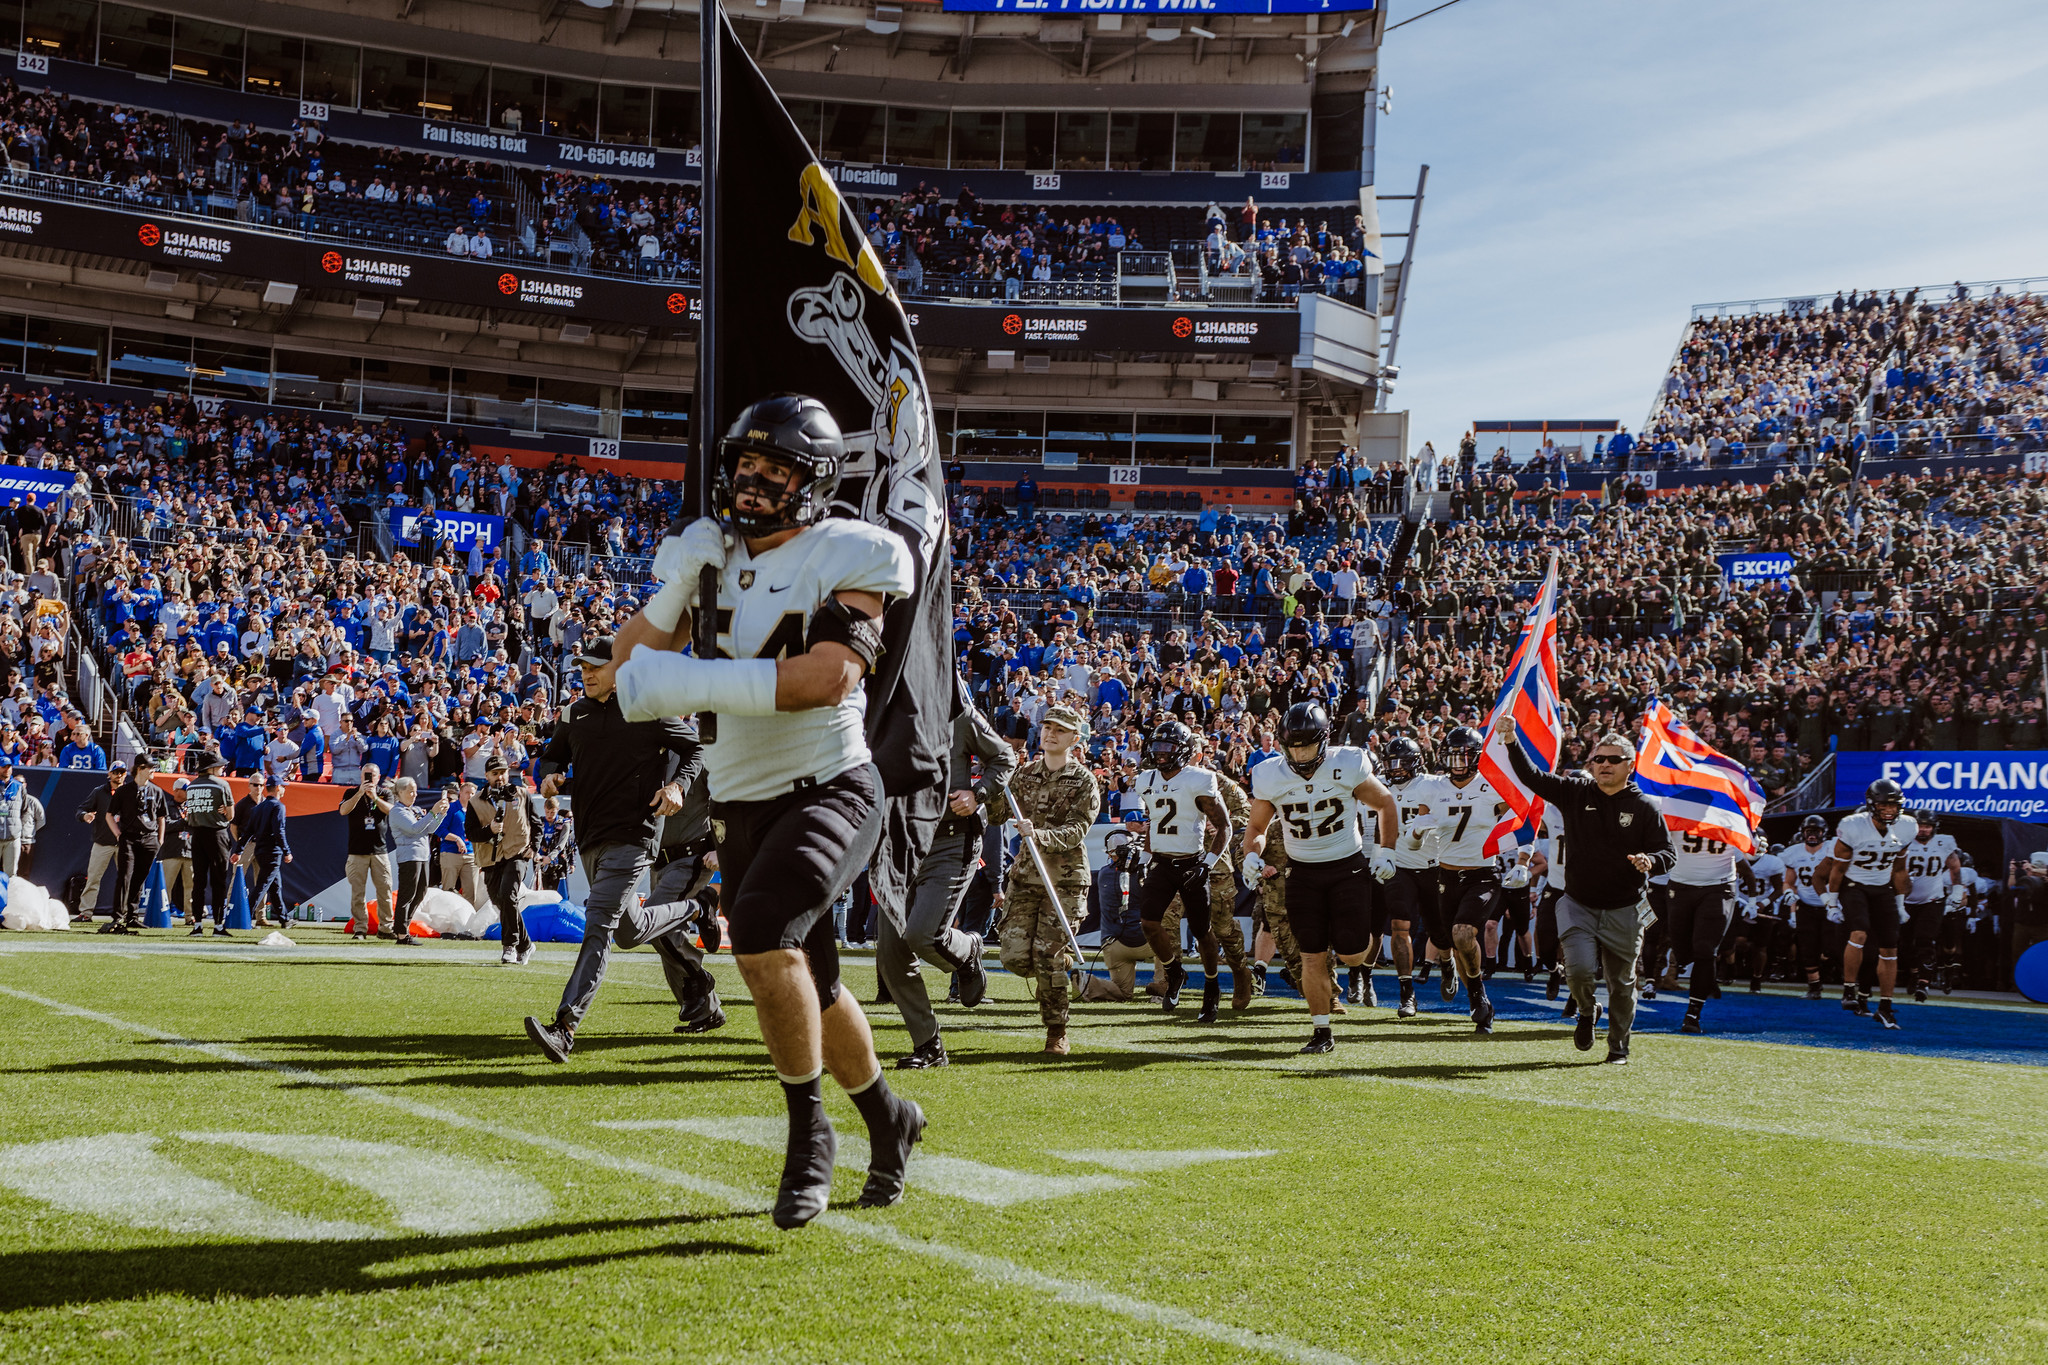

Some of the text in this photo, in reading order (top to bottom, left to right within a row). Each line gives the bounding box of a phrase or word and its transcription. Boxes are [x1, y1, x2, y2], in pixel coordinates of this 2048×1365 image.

[20, 55, 45, 71] 342
[302, 104, 326, 118] 343
[423, 123, 528, 154] Fan issues text
[559, 143, 656, 169] 720-650-6464
[687, 153, 702, 165] 34
[841, 166, 898, 186] location
[1035, 175, 1059, 188] 345
[1264, 174, 1287, 187] 346
[163, 231, 232, 254] L3HARRIS
[163, 246, 223, 262] FAST. FORWARD.
[345, 257, 411, 278] L3HARRIS
[345, 272, 403, 287] FAST. FORWARD.
[520, 279, 583, 299] L3HARRIS
[520, 294, 576, 308] FAST. FORWARD.
[1024, 318, 1088, 331] L3HARRIS
[1195, 321, 1259, 335] L3HARRIS
[1024, 332, 1080, 341] FAST. FORWARD.
[1195, 335, 1251, 344] FAST. FORWARD.
[196, 400, 221, 416] 127
[747, 429, 769, 440] ARMY
[592, 441, 617, 457] 128
[1112, 469, 1138, 483] 128
[0, 477, 66, 495] OEING
[1732, 560, 1797, 576] EXCHA
[73, 754, 92, 770] 63
[1333, 769, 1342, 780] C
[1480, 784, 1489, 792] C
[1155, 798, 1178, 835] 2
[1281, 797, 1345, 840] 52
[1448, 806, 1473, 843] 7
[1908, 856, 1943, 877] 60
